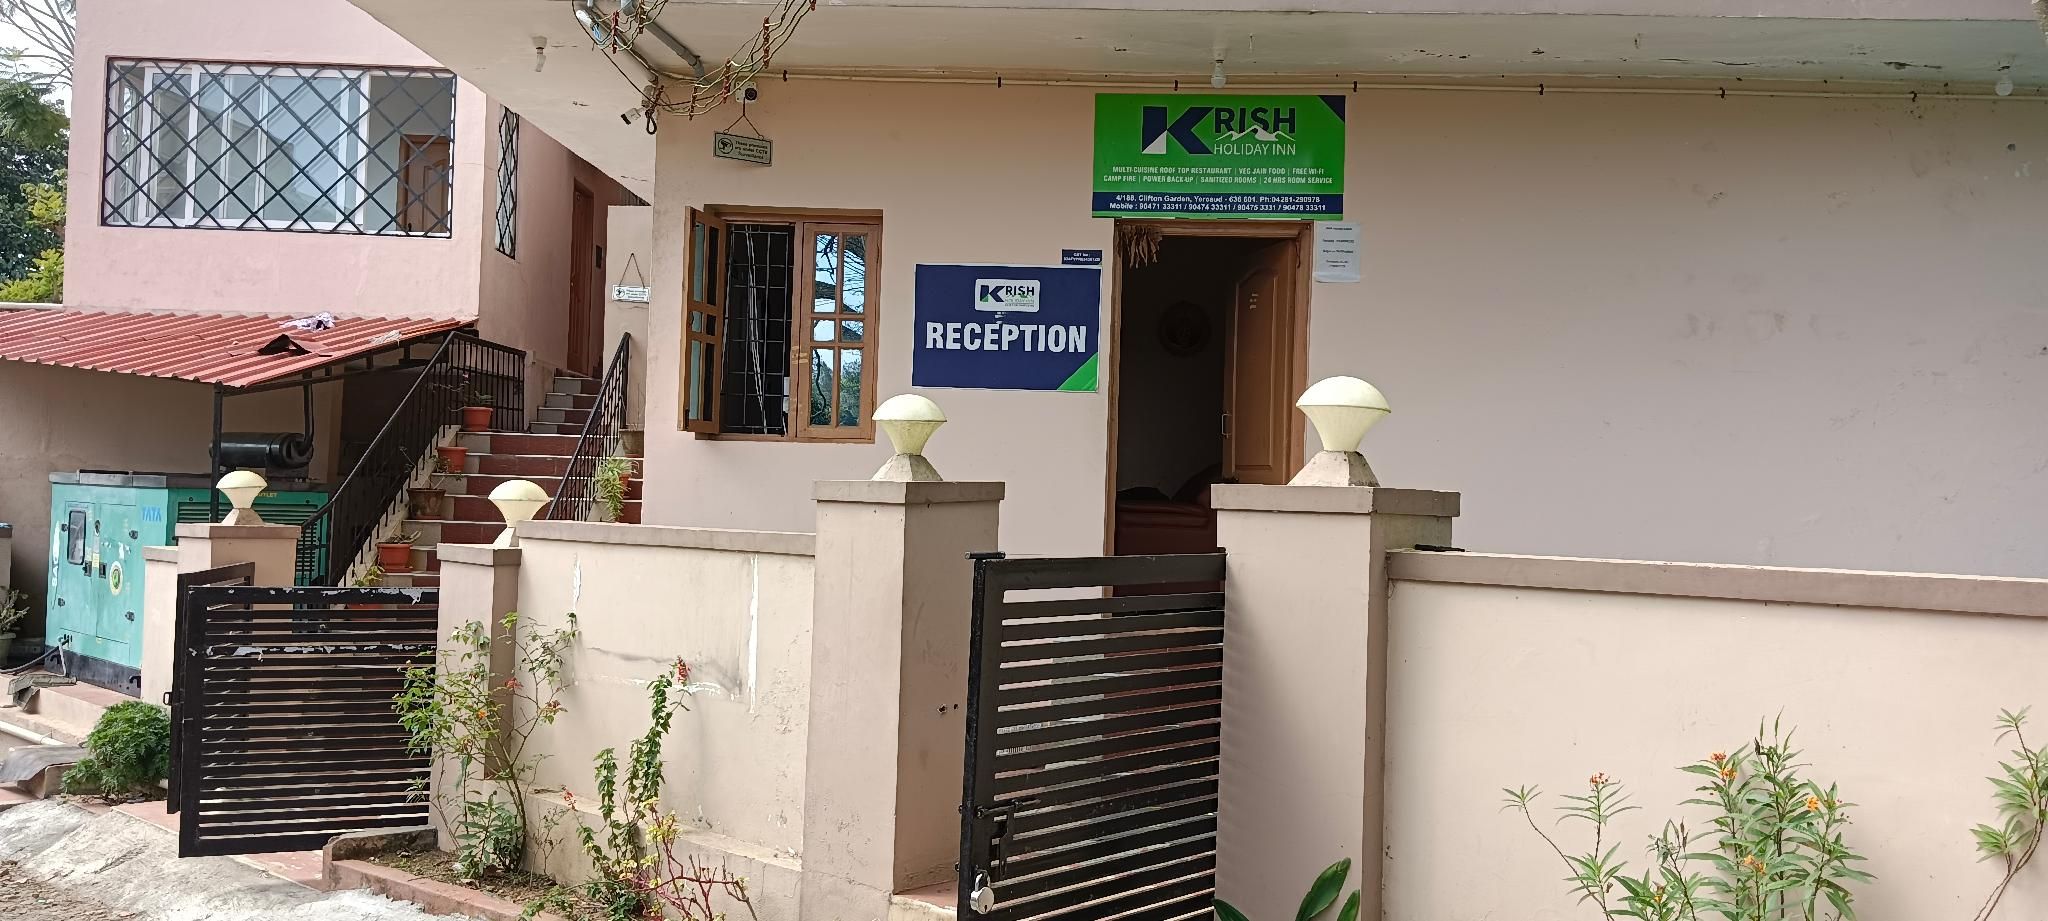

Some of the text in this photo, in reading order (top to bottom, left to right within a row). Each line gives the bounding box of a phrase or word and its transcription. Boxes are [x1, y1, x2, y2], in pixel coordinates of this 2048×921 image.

[1142, 105, 1297, 155] KRISH
[1213, 143, 1296, 156] HOLIDAY INN
[1112, 166, 1159, 174] MULTI-CUISINE
[1190, 167, 1232, 175] RESTAURANT
[1238, 167, 1251, 175] VEG
[1252, 167, 1267, 175] JAIN
[1268, 167, 1286, 175] FOOD
[1292, 167, 1308, 175] FREE
[1308, 167, 1325, 175] WI-FI
[1142, 175, 1166, 183] POWER
[1166, 175, 1194, 183] BACK-UP
[1200, 176, 1233, 184] SANITIZED
[1234, 176, 1257, 184] ROOMS
[1272, 176, 1287, 184] HRS
[1287, 176, 1306, 184] ROOM
[1138, 194, 1163, 202] Clifton
[1109, 202, 1134, 210] Mobile
[980, 284, 1035, 303] KRISH
[926, 322, 1087, 353] RECEPTION
[142, 506, 162, 522] TATA
